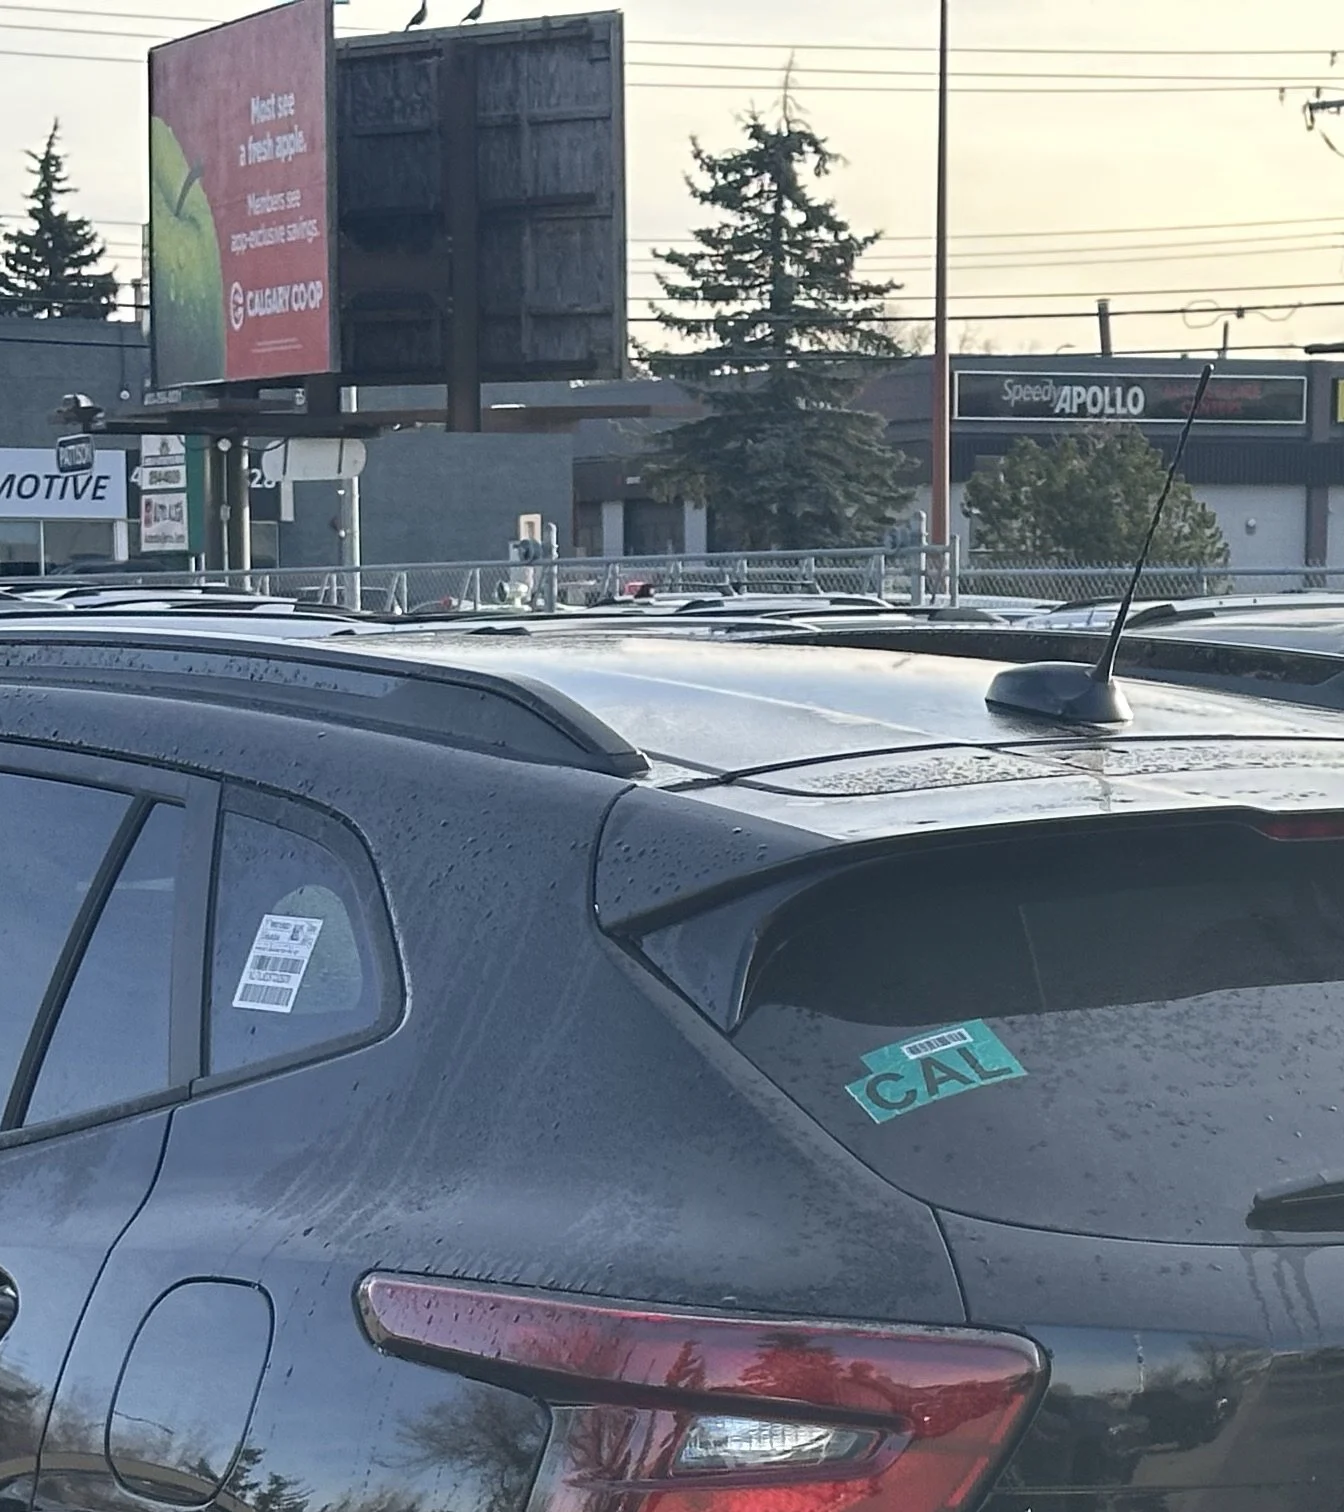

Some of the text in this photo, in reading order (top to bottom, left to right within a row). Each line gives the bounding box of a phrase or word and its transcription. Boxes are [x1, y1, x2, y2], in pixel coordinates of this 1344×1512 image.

[239, 143, 246, 167] a
[247, 131, 274, 165] fresh
[246, 284, 291, 317] CALGARY
[1001, 378, 1057, 407] Speedy
[1054, 385, 1145, 415] APOLLO
[865, 1046, 1014, 1111] CAL
